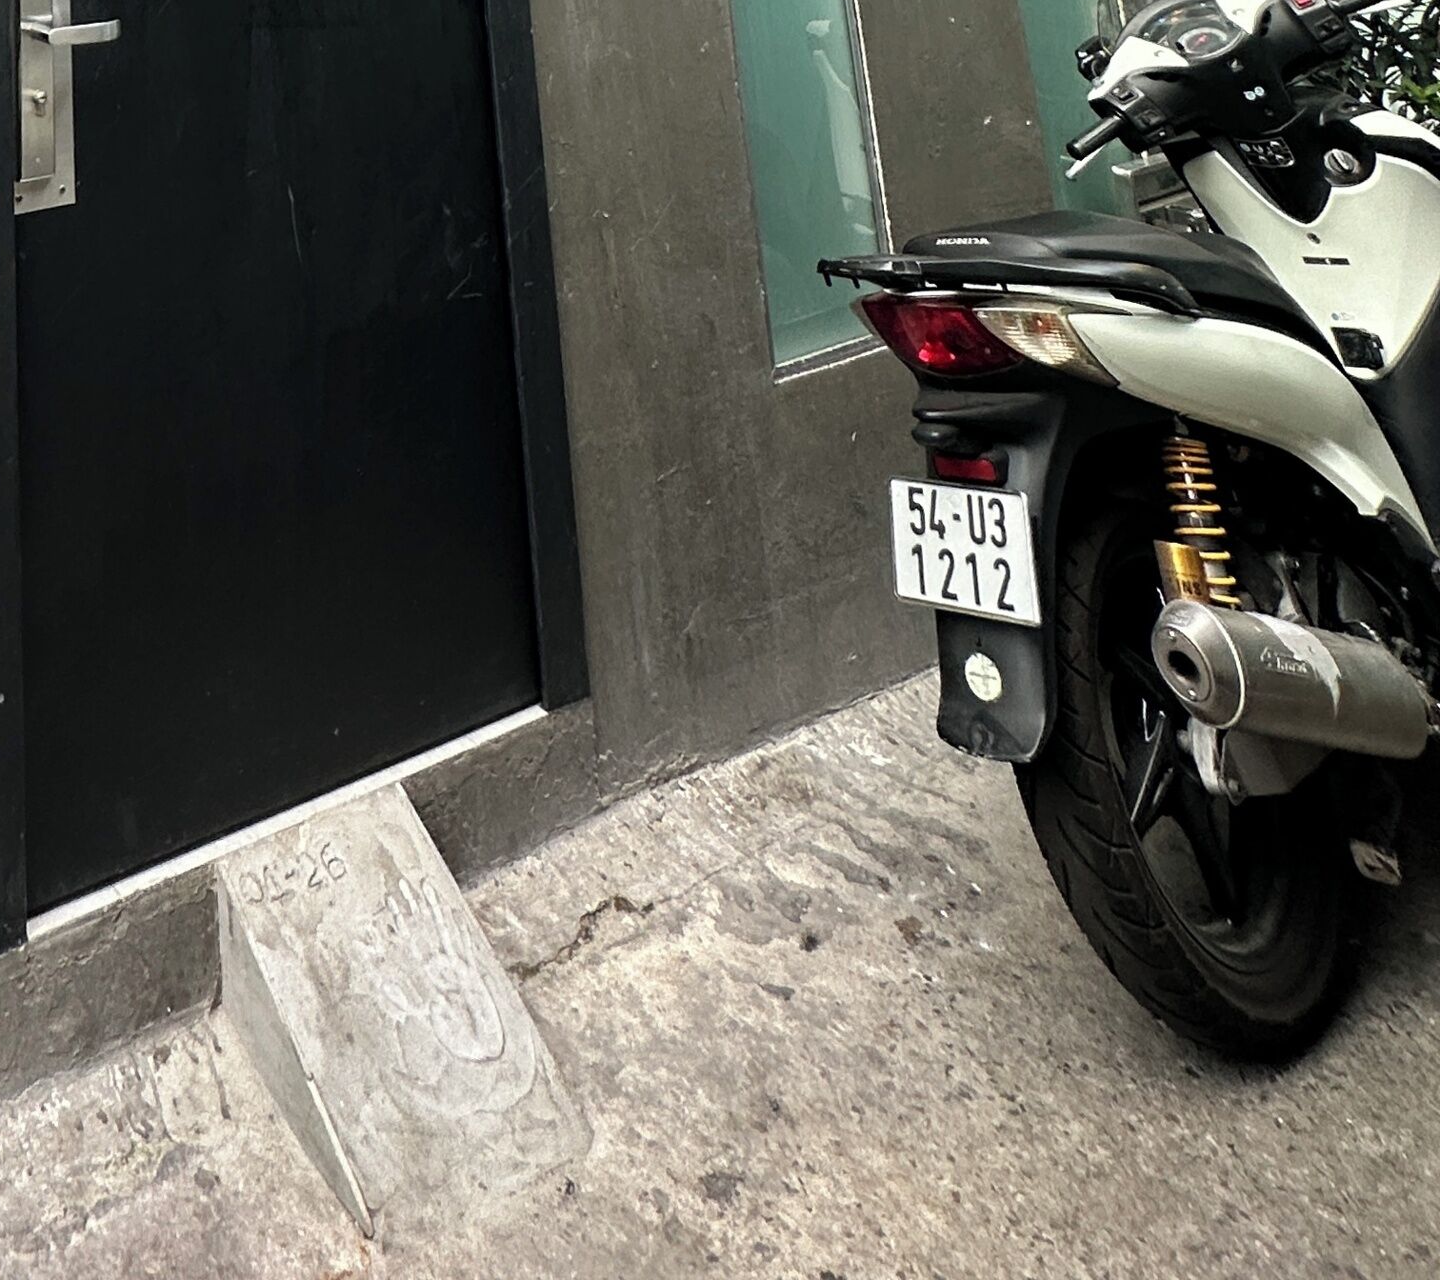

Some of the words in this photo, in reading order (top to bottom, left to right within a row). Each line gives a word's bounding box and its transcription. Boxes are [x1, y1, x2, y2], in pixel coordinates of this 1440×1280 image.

[936, 237, 990, 246] HONDA
[908, 486, 1007, 548] 54-U3
[912, 543, 1015, 612] 1212
